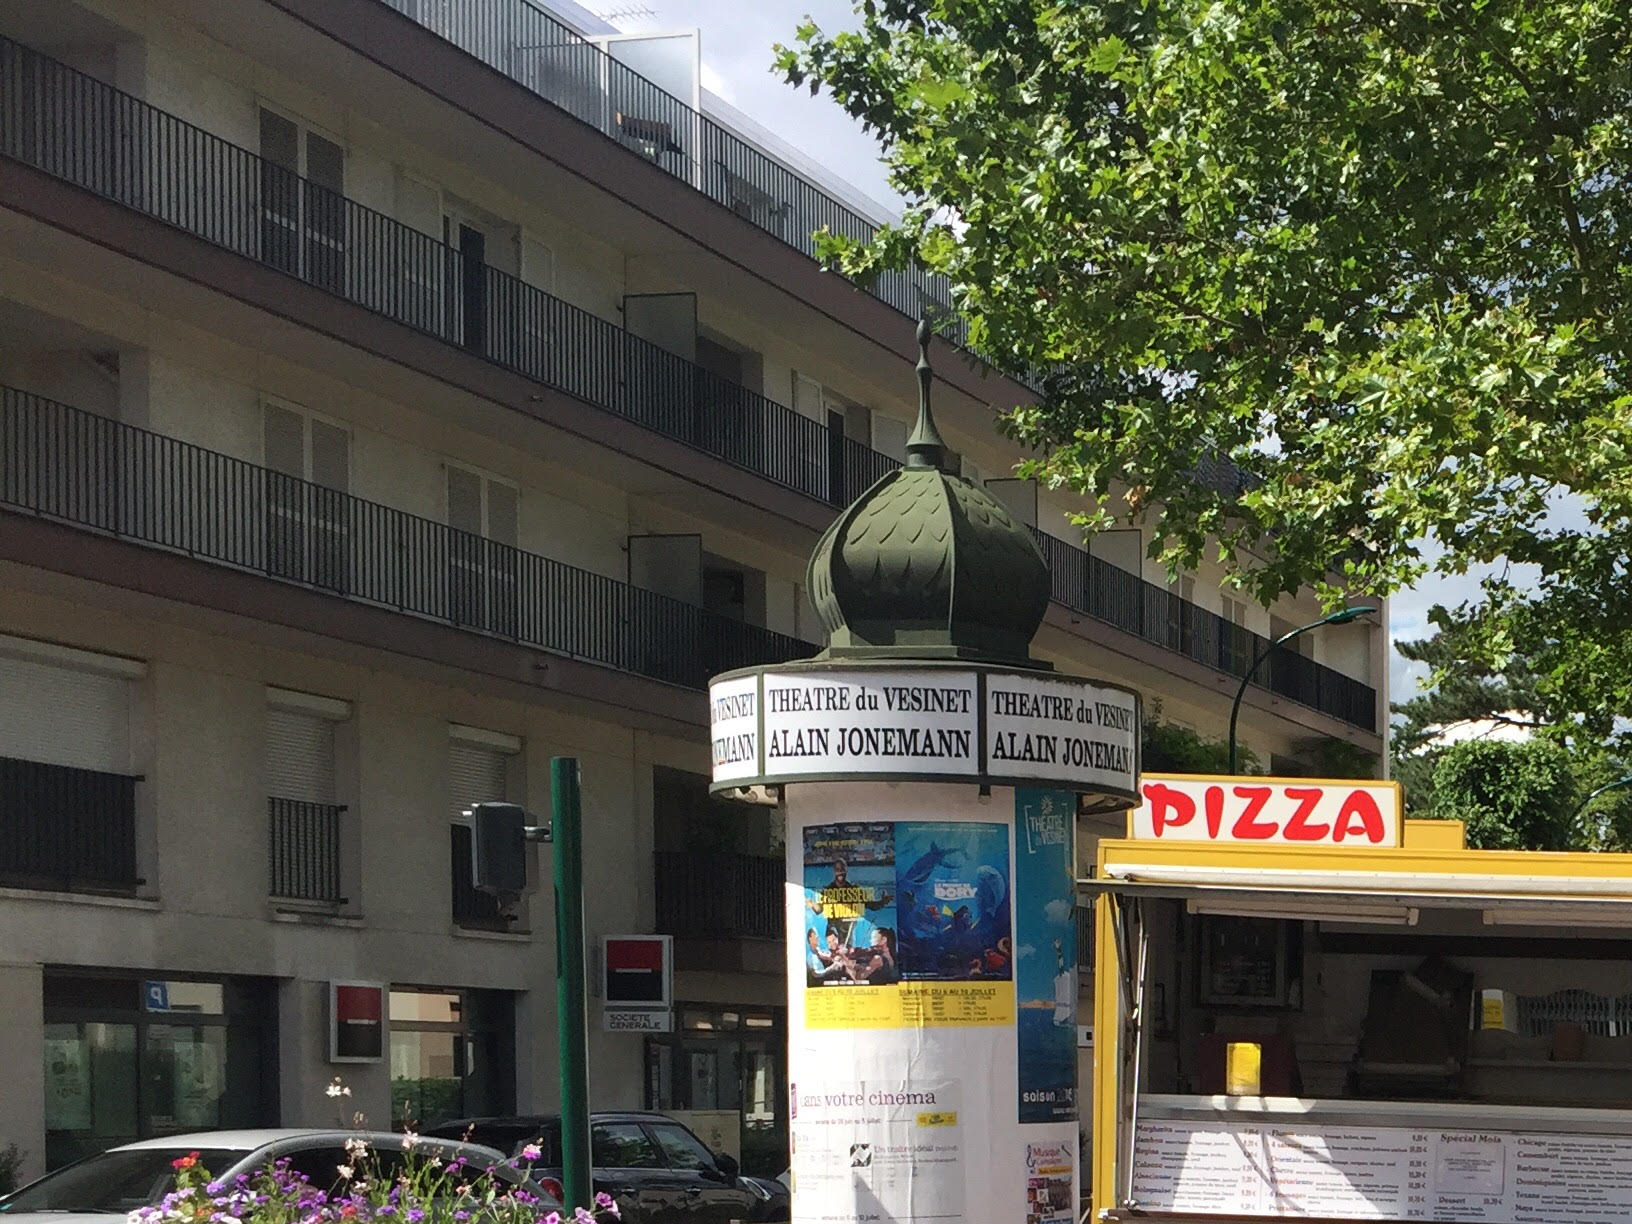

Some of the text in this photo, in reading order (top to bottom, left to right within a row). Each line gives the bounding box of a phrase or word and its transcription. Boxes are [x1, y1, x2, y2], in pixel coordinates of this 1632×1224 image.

[769, 685, 972, 713] THEATRE du VESINET
[992, 691, 1133, 733] THEATRE du VESINET
[769, 727, 971, 758] ALAIN JONEMANN
[992, 731, 1057, 763] ALAIN
[1143, 783, 1385, 844] PIZZA
[609, 1014, 651, 1022] SOCIETE
[609, 1022, 661, 1030] GENERALE
[824, 1092, 864, 1106] votre
